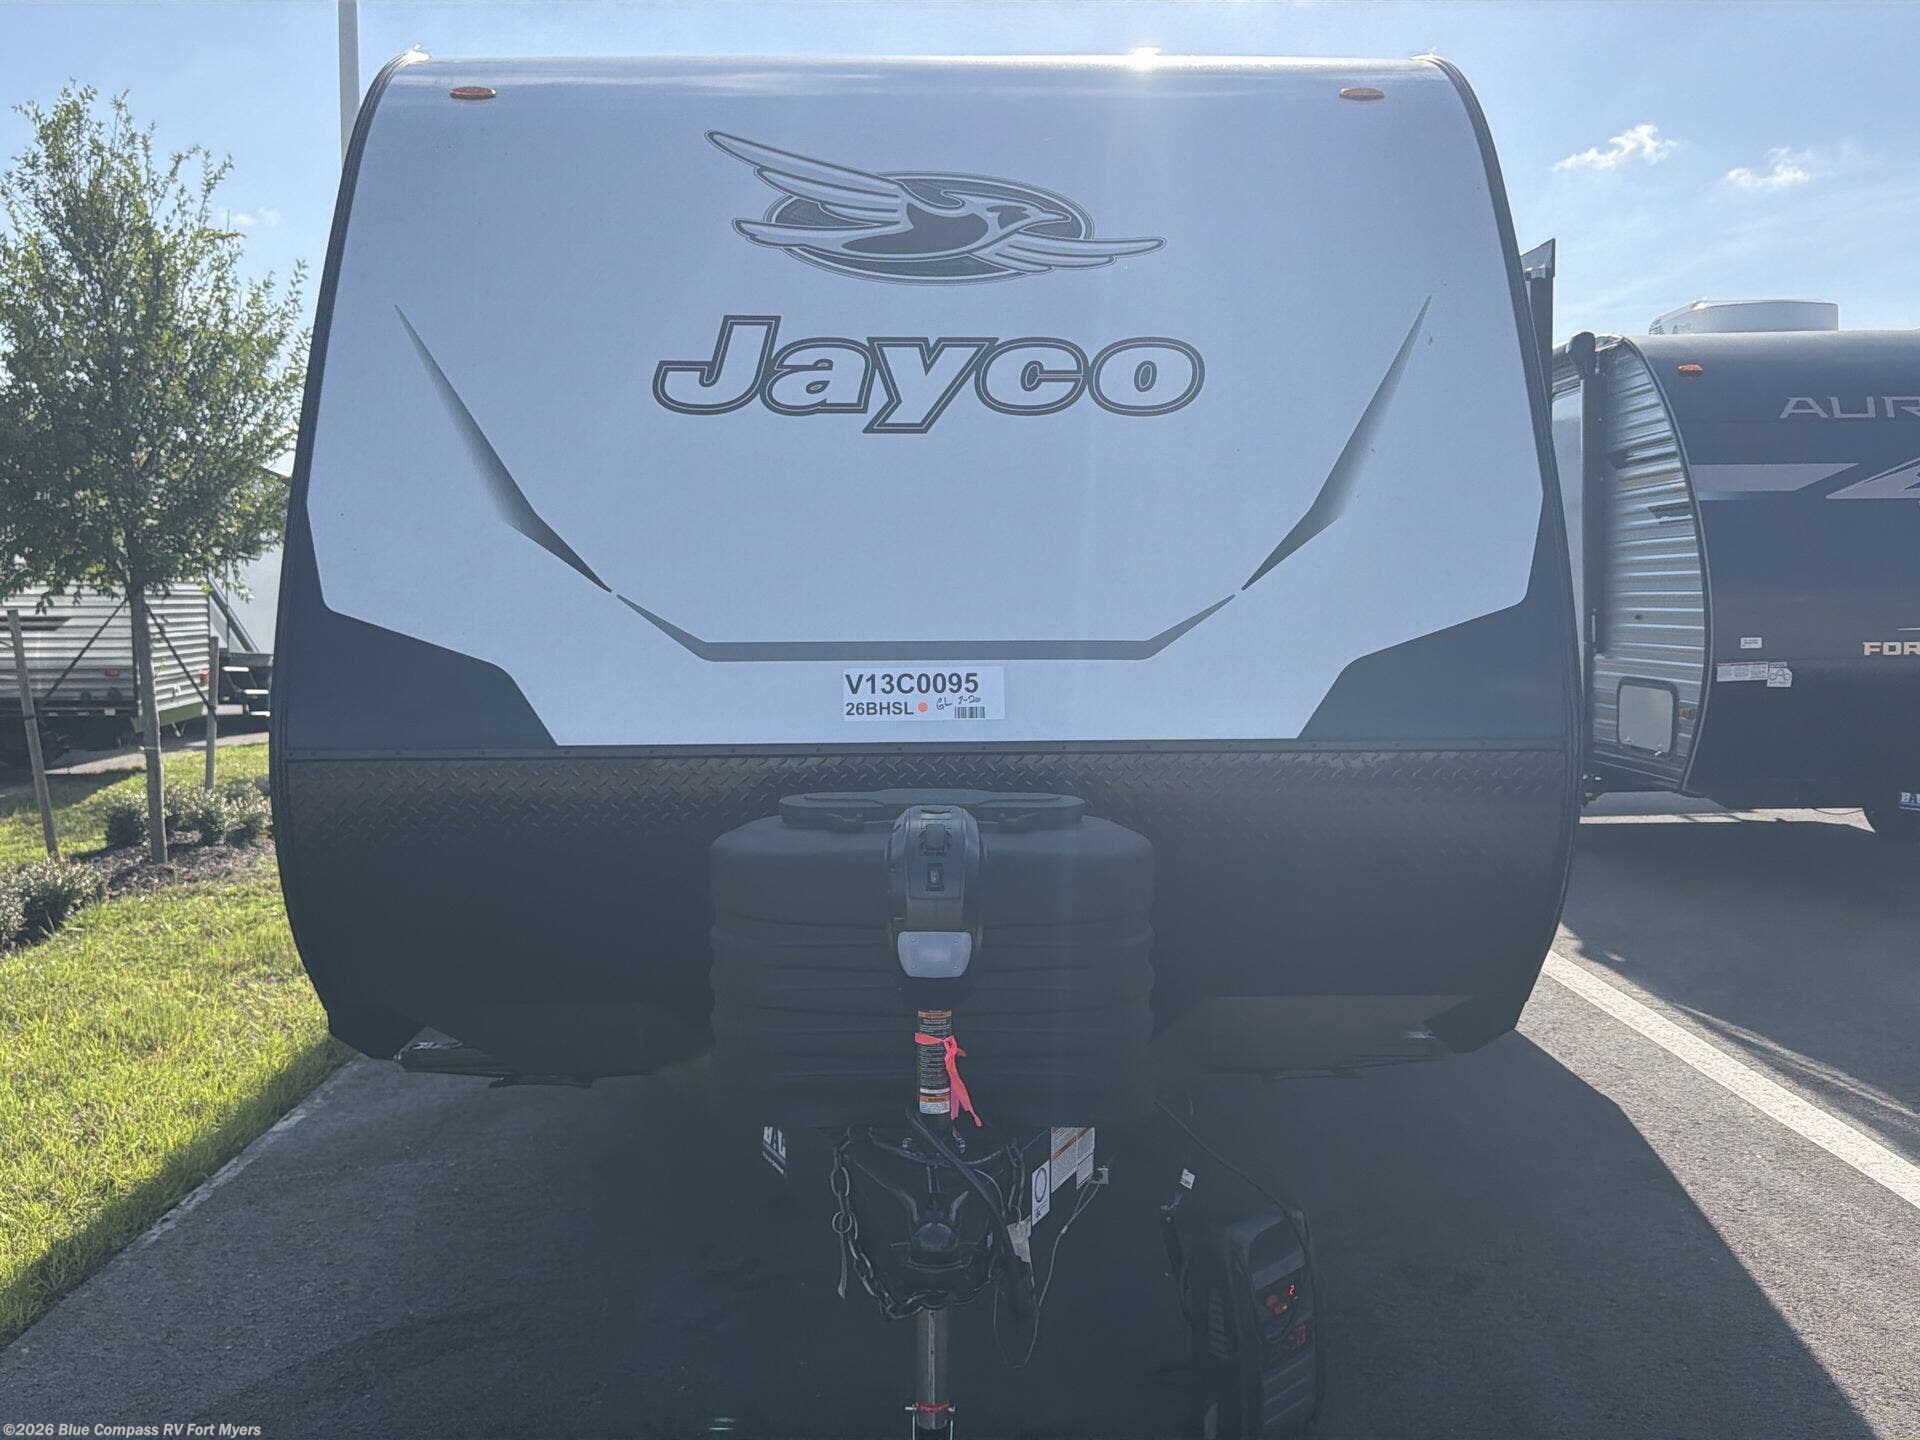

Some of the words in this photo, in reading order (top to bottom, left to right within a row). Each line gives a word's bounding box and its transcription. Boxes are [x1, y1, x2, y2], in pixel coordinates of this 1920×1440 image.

[652, 315, 1205, 434] Jayco
[1778, 396, 1920, 419] AUR
[1862, 641, 1920, 656] FOR
[845, 672, 979, 695] V13C0095
[845, 701, 914, 716] 26BHSL
